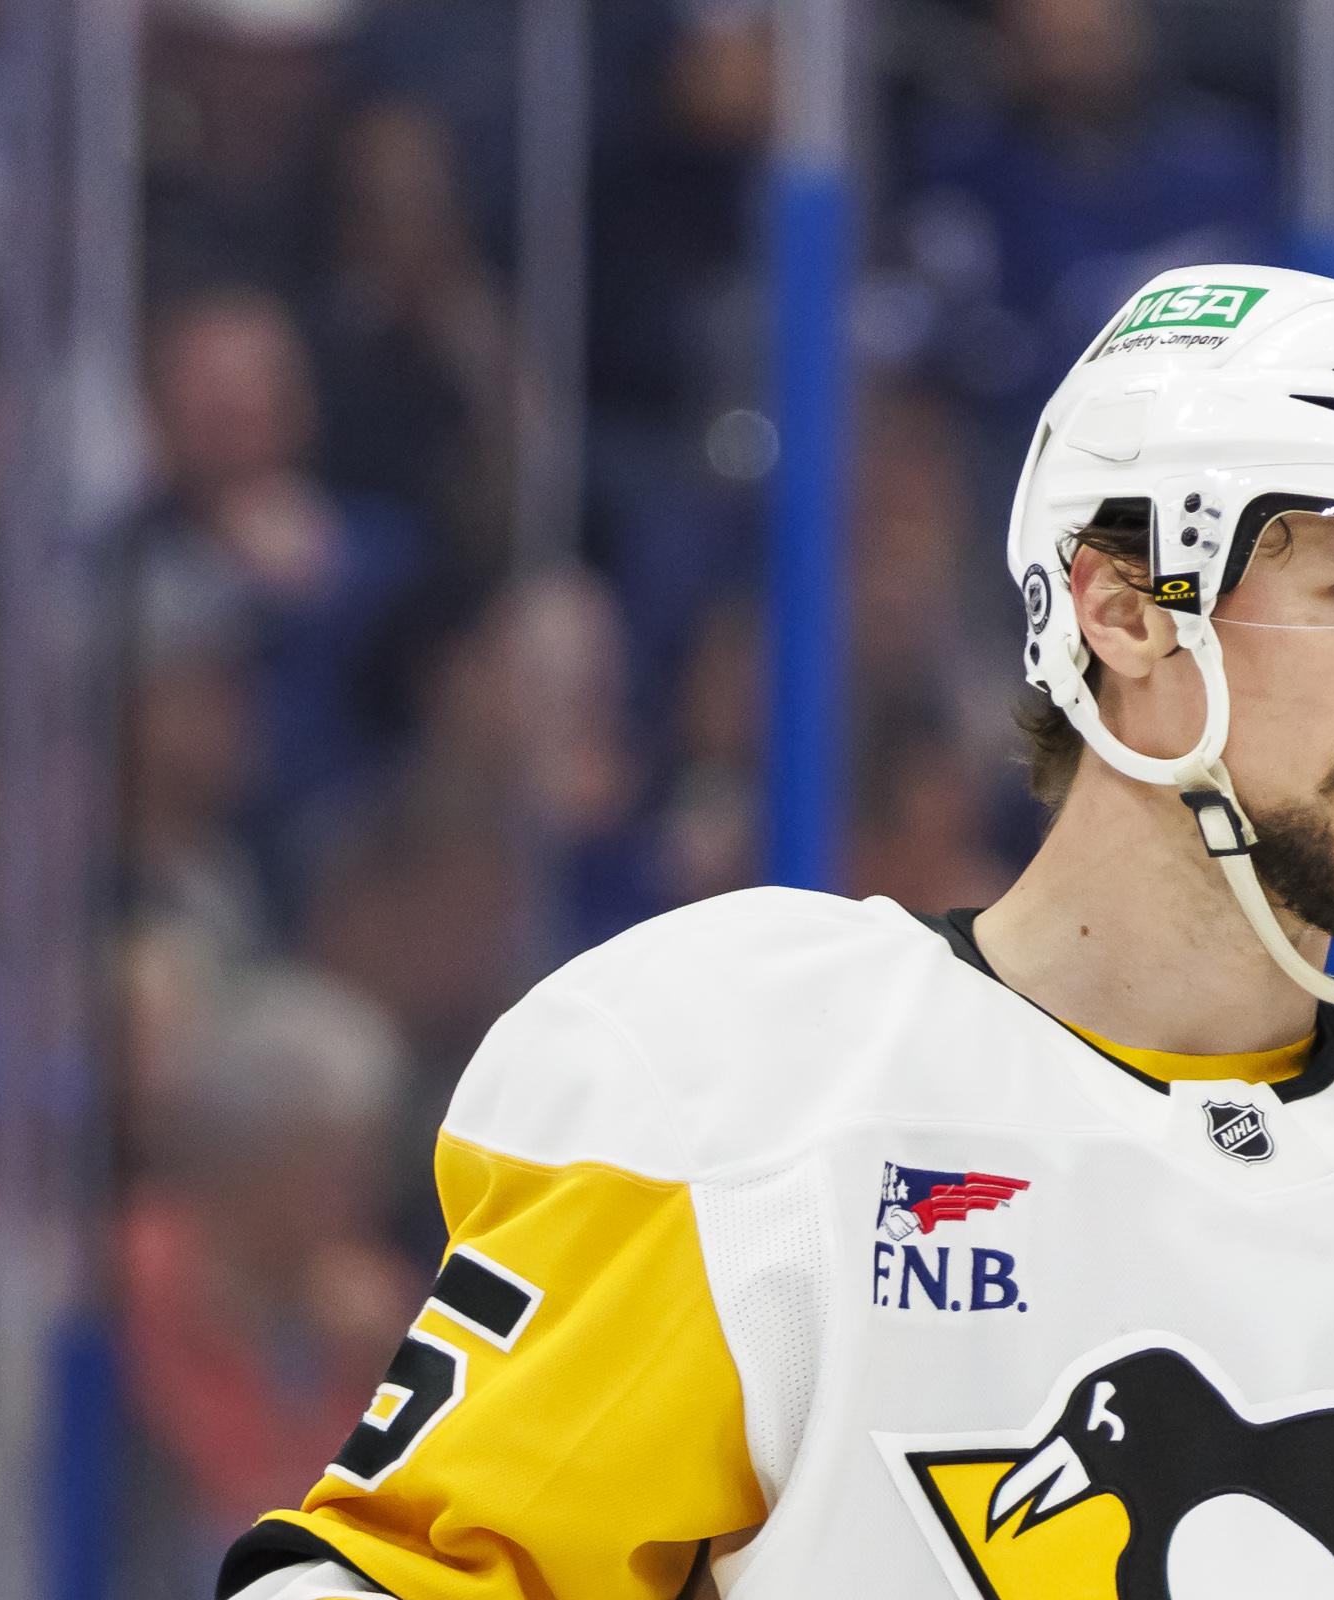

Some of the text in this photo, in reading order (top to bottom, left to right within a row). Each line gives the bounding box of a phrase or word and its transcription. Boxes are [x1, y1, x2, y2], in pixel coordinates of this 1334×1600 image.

[1116, 286, 1248, 336] MSA
[1220, 1116, 1259, 1148] NHL
[873, 1240, 1028, 1313] F.N.B.
